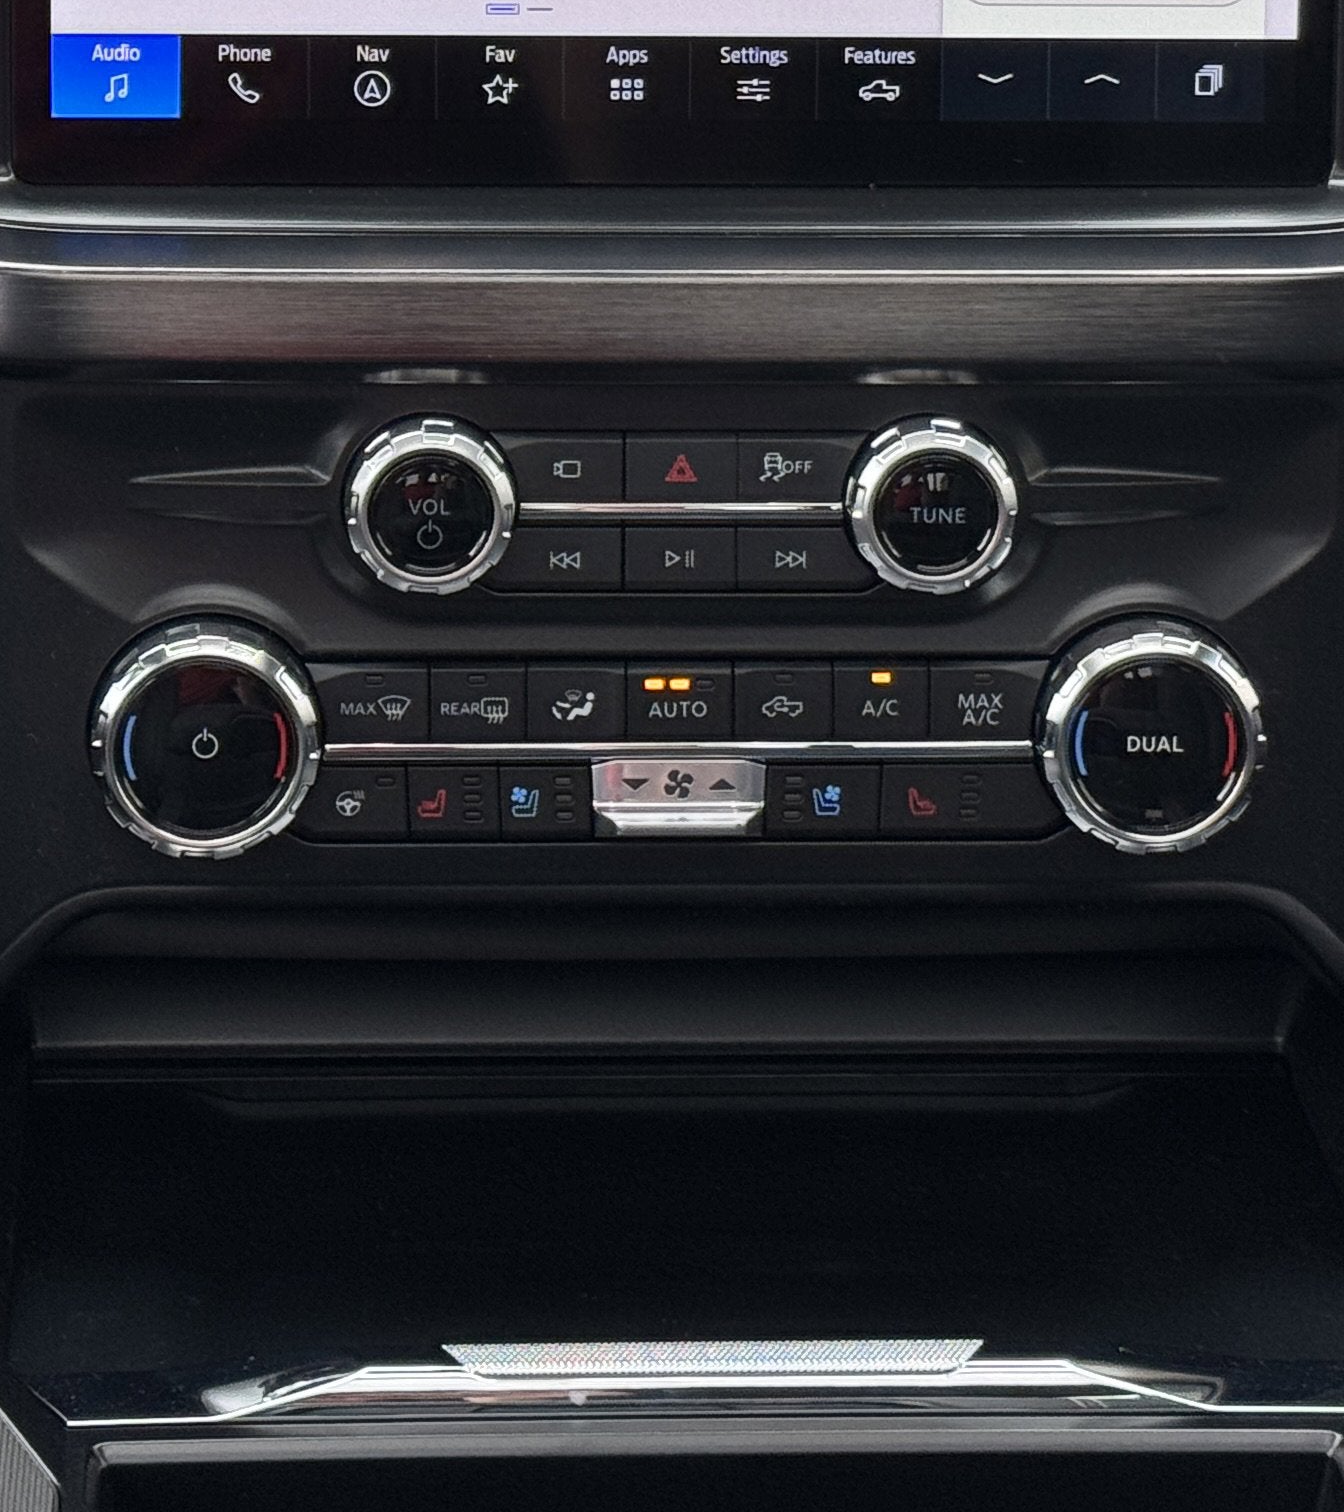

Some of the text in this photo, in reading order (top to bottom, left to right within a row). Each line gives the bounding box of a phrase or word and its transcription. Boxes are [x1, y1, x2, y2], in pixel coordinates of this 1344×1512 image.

[91, 43, 141, 62] Audio
[218, 43, 272, 62] Phone
[356, 44, 390, 63] Nav
[485, 45, 516, 63] Fav
[605, 45, 649, 67] Apps
[720, 46, 789, 68] Settings
[844, 46, 916, 65] Features
[782, 460, 813, 477] OFF
[408, 498, 451, 516] VOL
[909, 506, 966, 524] TUNE
[340, 702, 377, 716] MAX
[440, 702, 481, 716] REAR
[648, 700, 708, 718] AUTO
[861, 698, 899, 718] A/C
[957, 693, 1003, 711] MAX
[962, 708, 999, 726] A/C
[1126, 735, 1184, 753] DUAL
